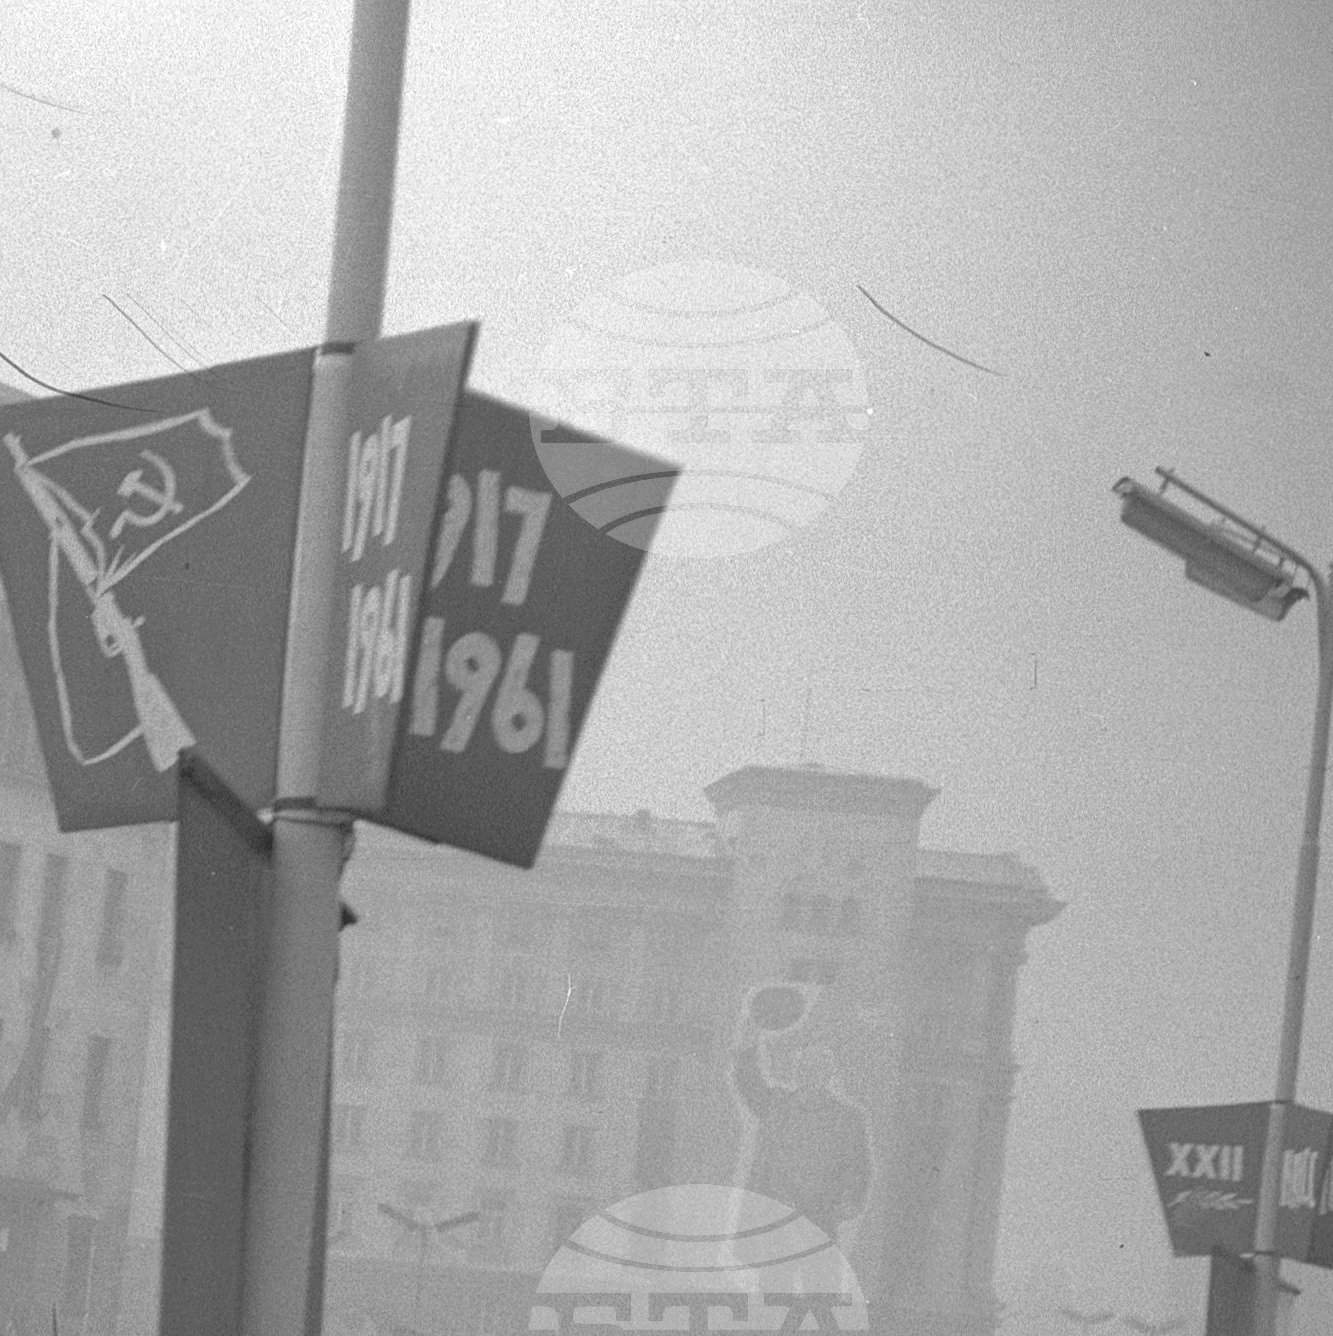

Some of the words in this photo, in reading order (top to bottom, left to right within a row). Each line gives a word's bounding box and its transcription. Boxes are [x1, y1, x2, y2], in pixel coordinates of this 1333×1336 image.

[342, 415, 413, 561] 1917
[342, 570, 413, 714] 1961
[409, 617, 575, 769] 1961
[1164, 1142, 1244, 1181] XXII
